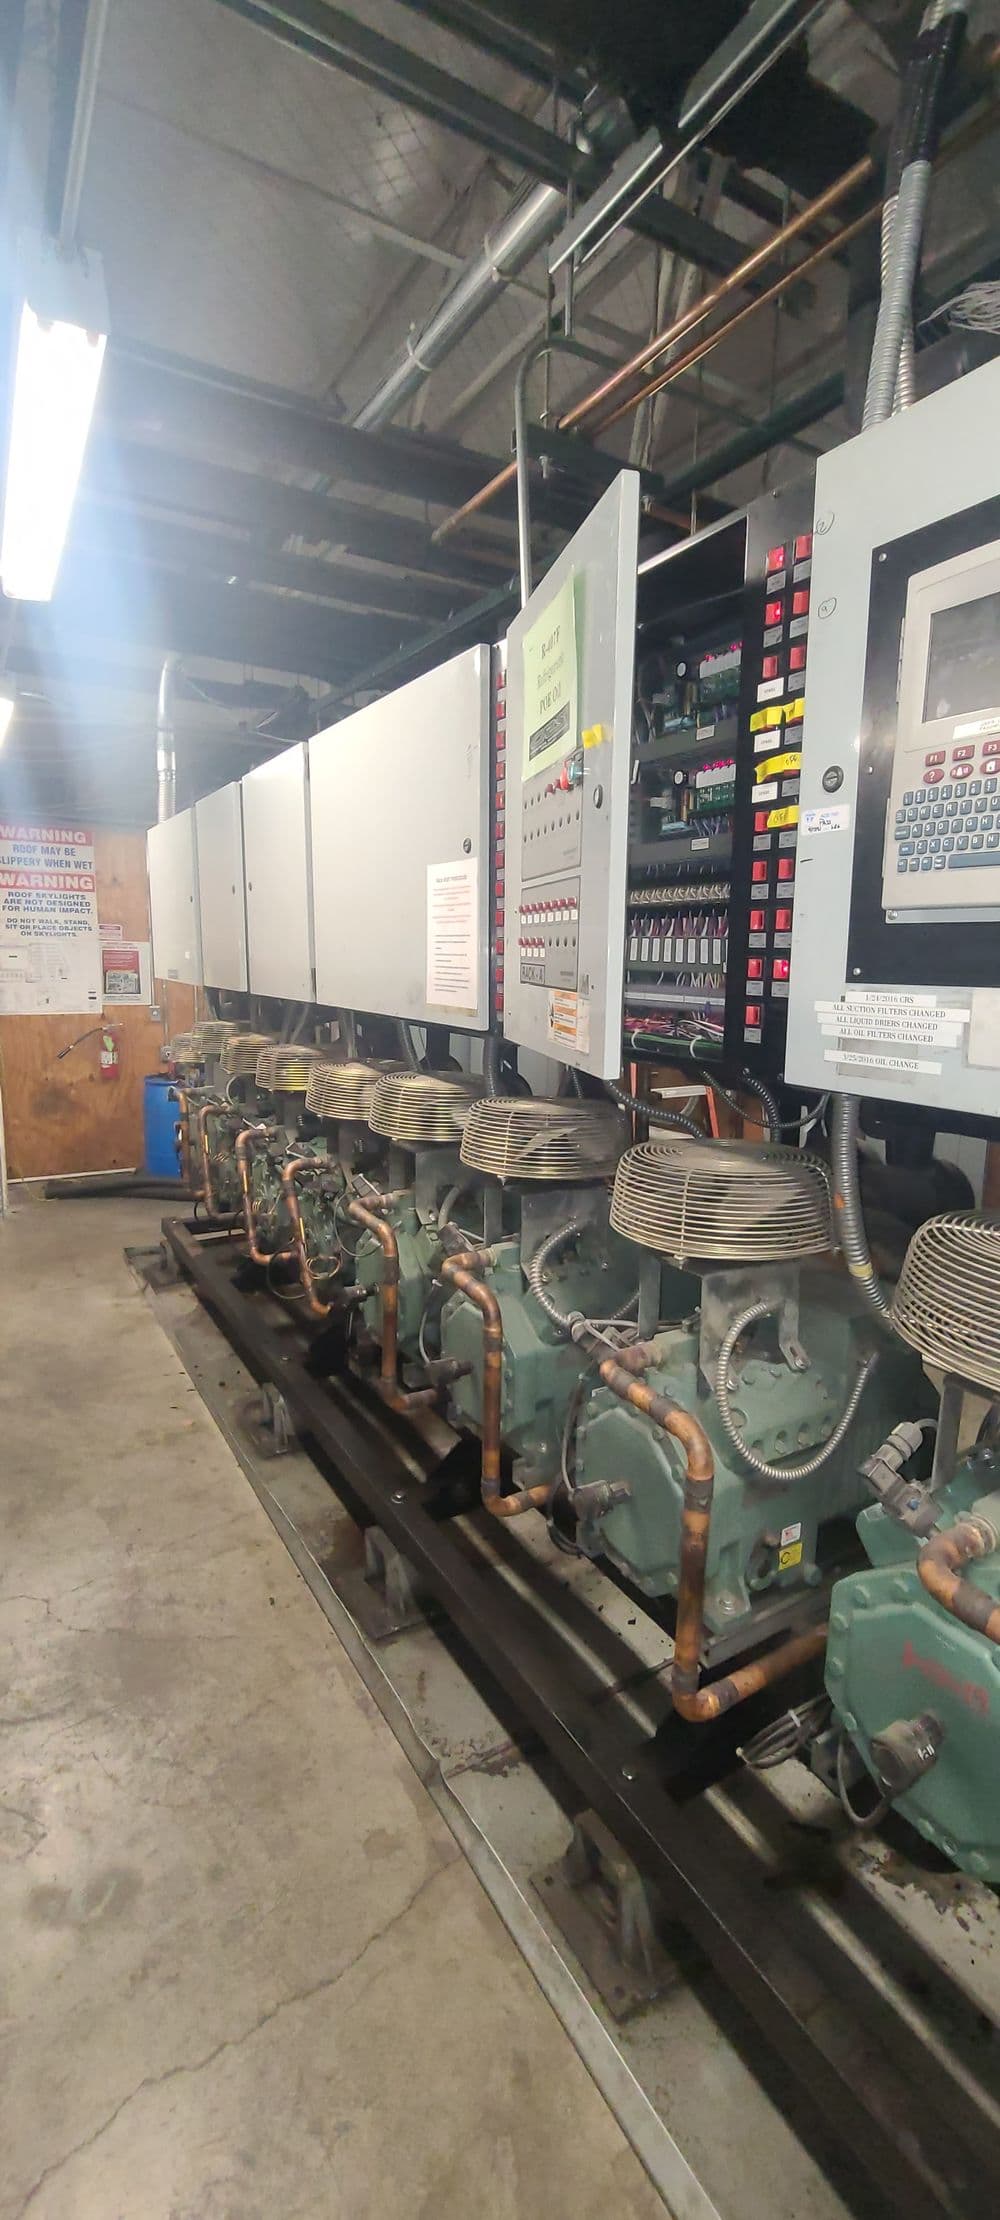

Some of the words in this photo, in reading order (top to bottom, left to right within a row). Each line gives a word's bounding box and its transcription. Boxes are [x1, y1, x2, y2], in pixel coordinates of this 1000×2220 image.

[958, 750, 966, 758] F2
[0, 824, 86, 844] WARNING
[13, 844, 37, 853] ROOF
[41, 846, 61, 856] MAY
[64, 848, 76, 857] BE
[44, 859, 71, 869] WHEN
[73, 861, 93, 870] WET
[0, 873, 94, 890] WARNING
[36, 892, 86, 900] SKYLIGHTS
[900, 996, 914, 1004] CRS
[847, 1005, 875, 1014] SUCTION
[877, 1007, 907, 1016] FILTERS
[908, 1009, 945, 1018] CHANGED
[849, 1017, 872, 1025] LIQUID
[874, 1019, 900, 1027] DRIERS
[902, 1021, 938, 1031] CHANGED
[867, 1030, 896, 1040] FILTERS
[897, 1033, 934, 1043] CHANGED
[888, 1060, 919, 1069] CHANGE
